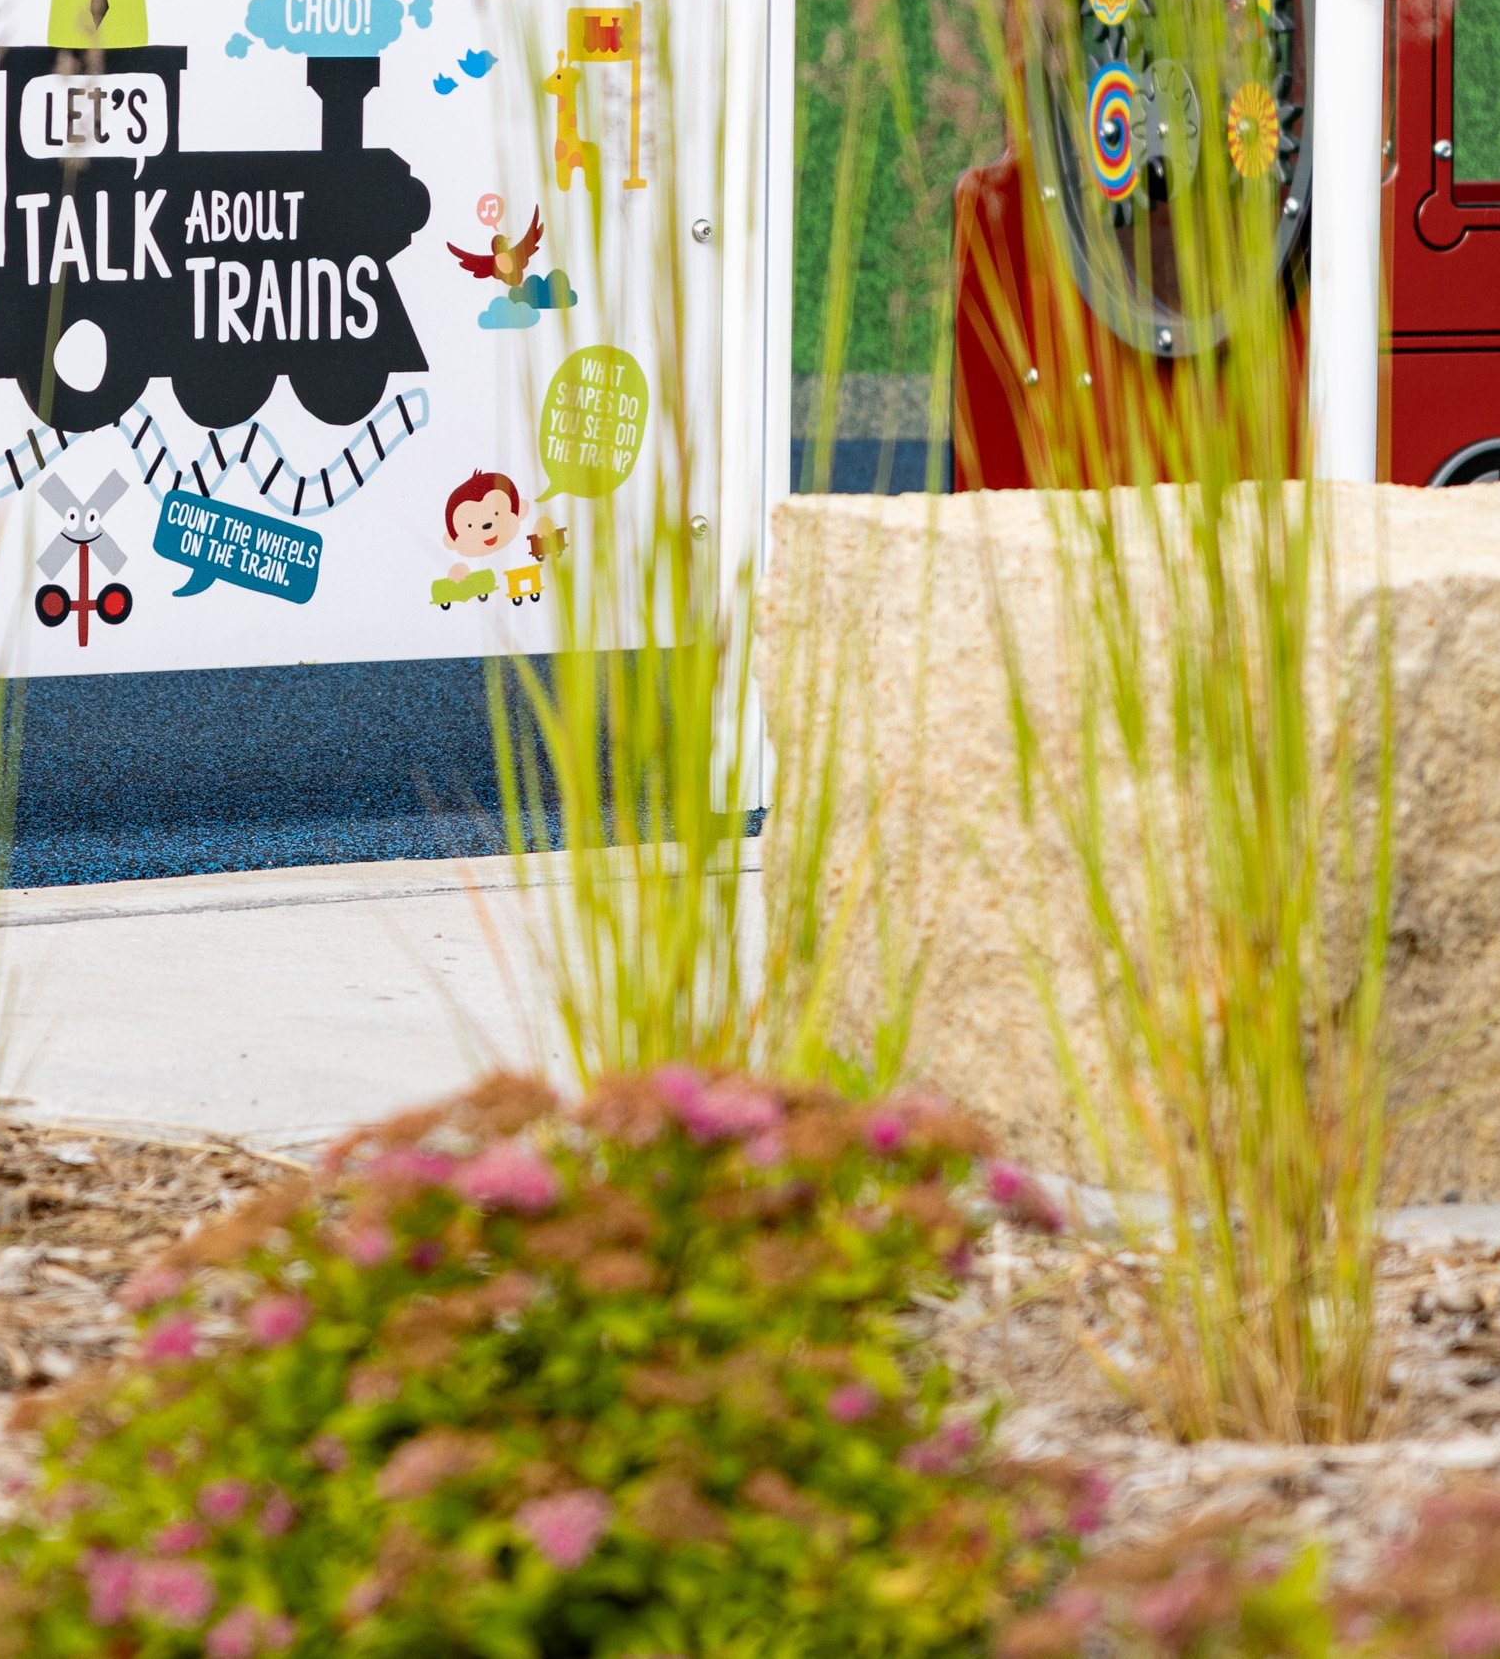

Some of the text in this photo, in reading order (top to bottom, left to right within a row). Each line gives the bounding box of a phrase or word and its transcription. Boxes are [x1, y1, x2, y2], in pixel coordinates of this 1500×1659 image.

[15, 189, 172, 285] TALK
[550, 408, 580, 435] YOU
[583, 415, 613, 440] SE
[618, 393, 638, 420] DO
[547, 436, 632, 474] THE TRAN?
[167, 501, 220, 535] COUNT
[180, 530, 204, 557] ON
[207, 539, 236, 568] THE
